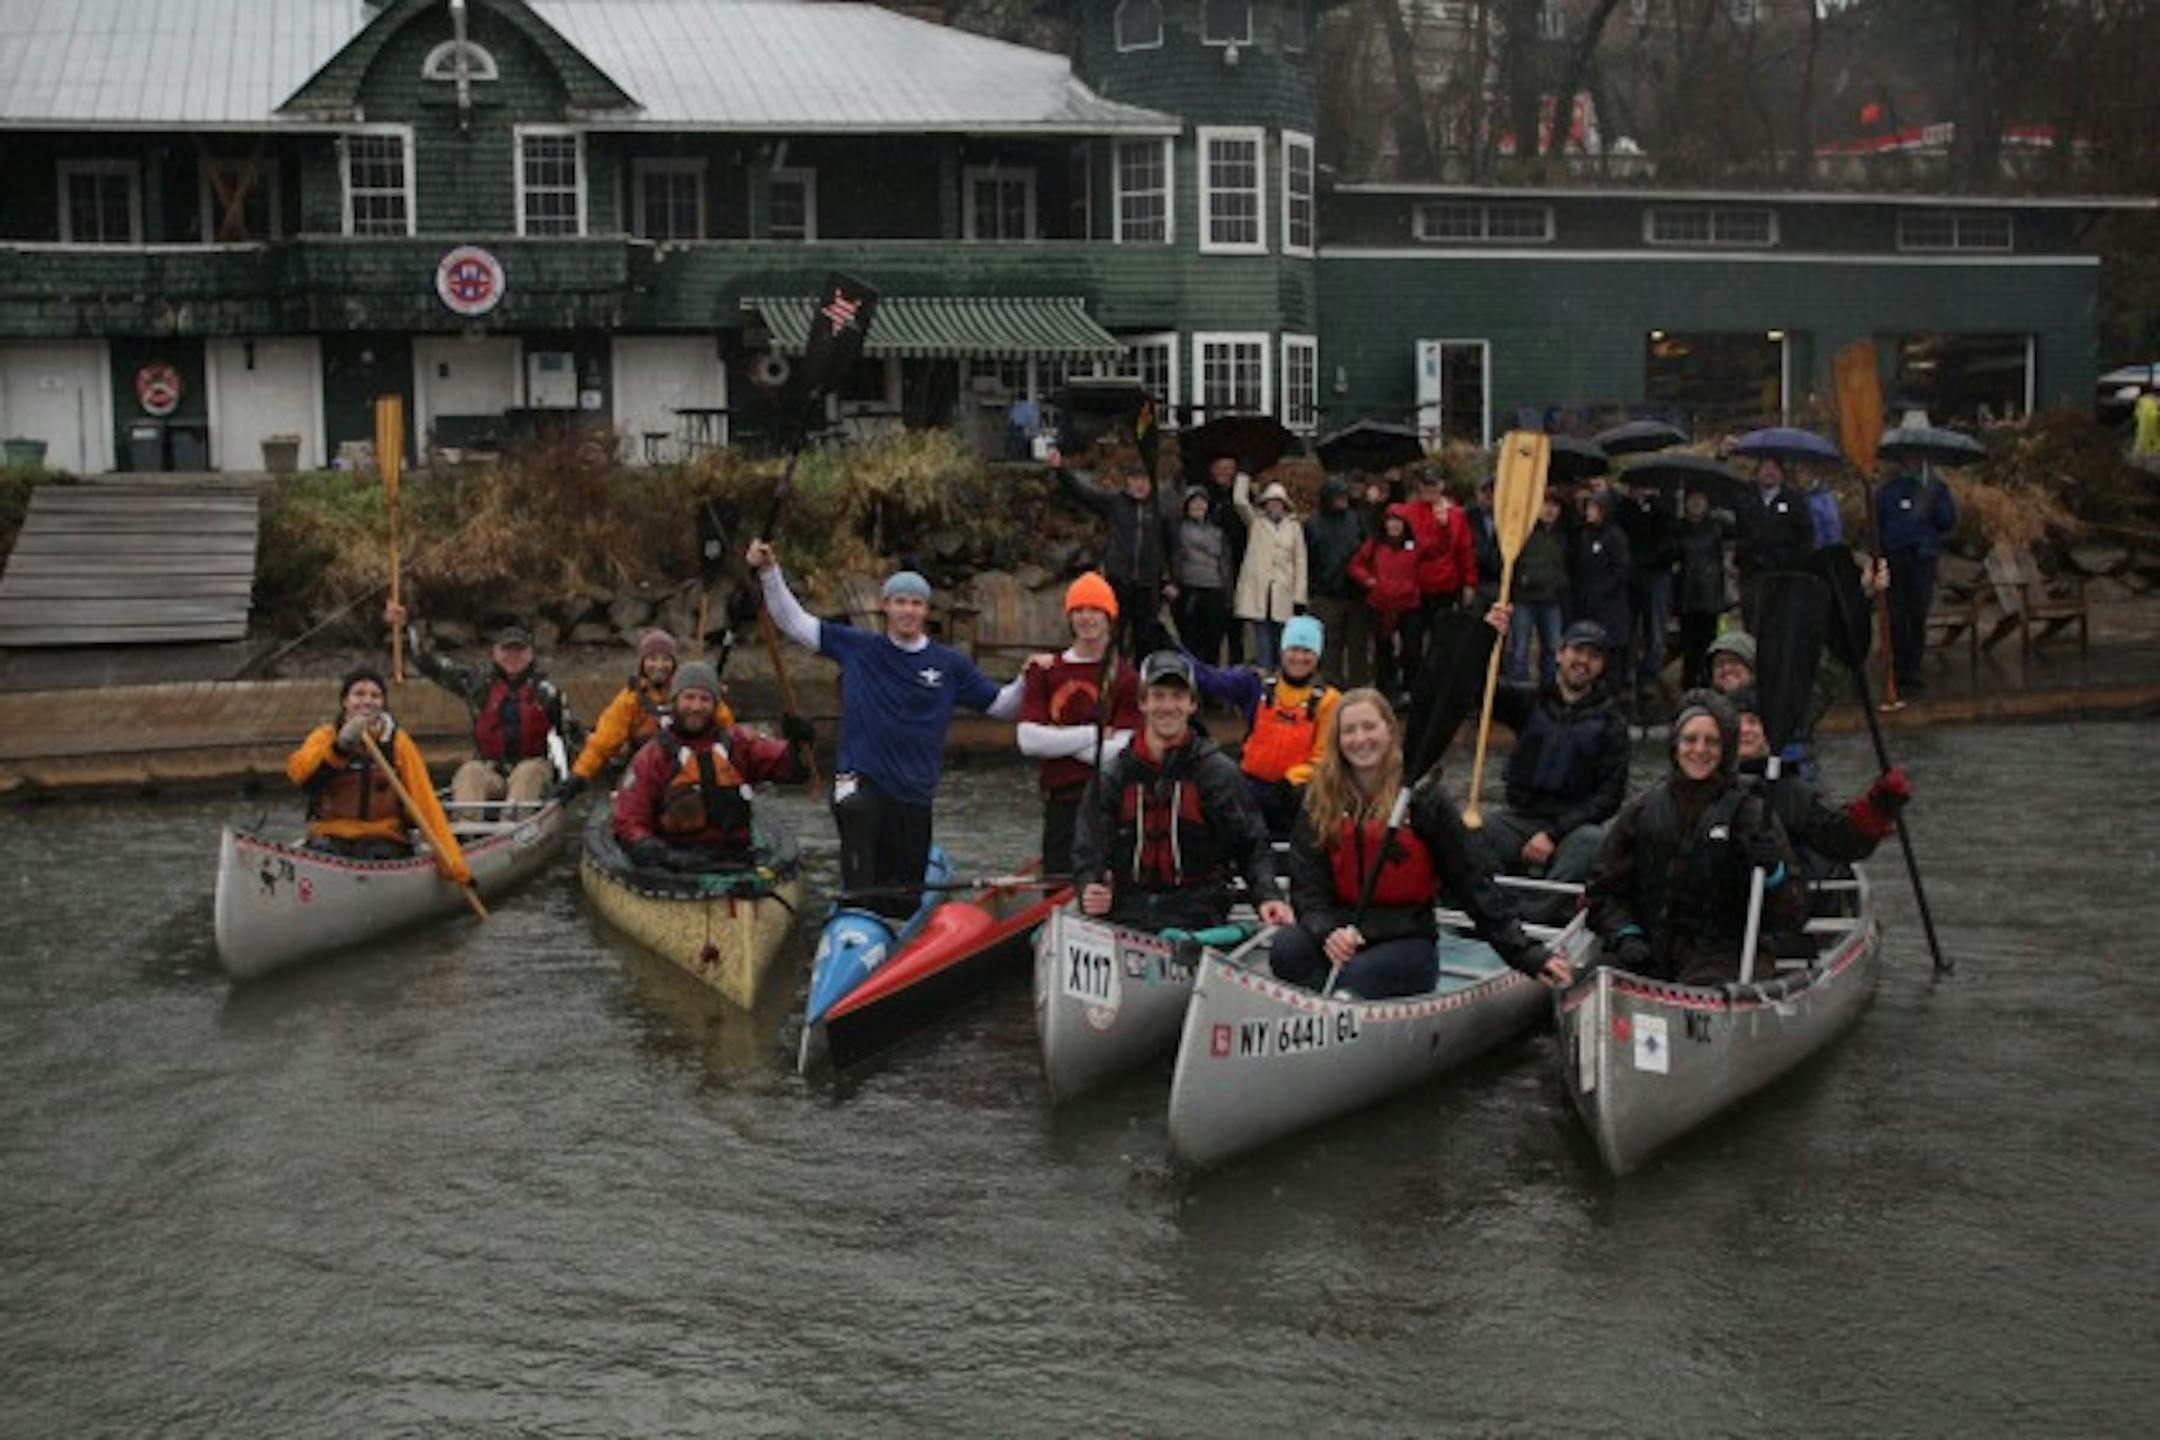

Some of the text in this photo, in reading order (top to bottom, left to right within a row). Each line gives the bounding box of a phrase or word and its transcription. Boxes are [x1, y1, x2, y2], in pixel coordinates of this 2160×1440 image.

[1069, 946, 1111, 998] X117
[1240, 1021, 1268, 1055] NY
[1278, 1015, 1325, 1051] 6441
